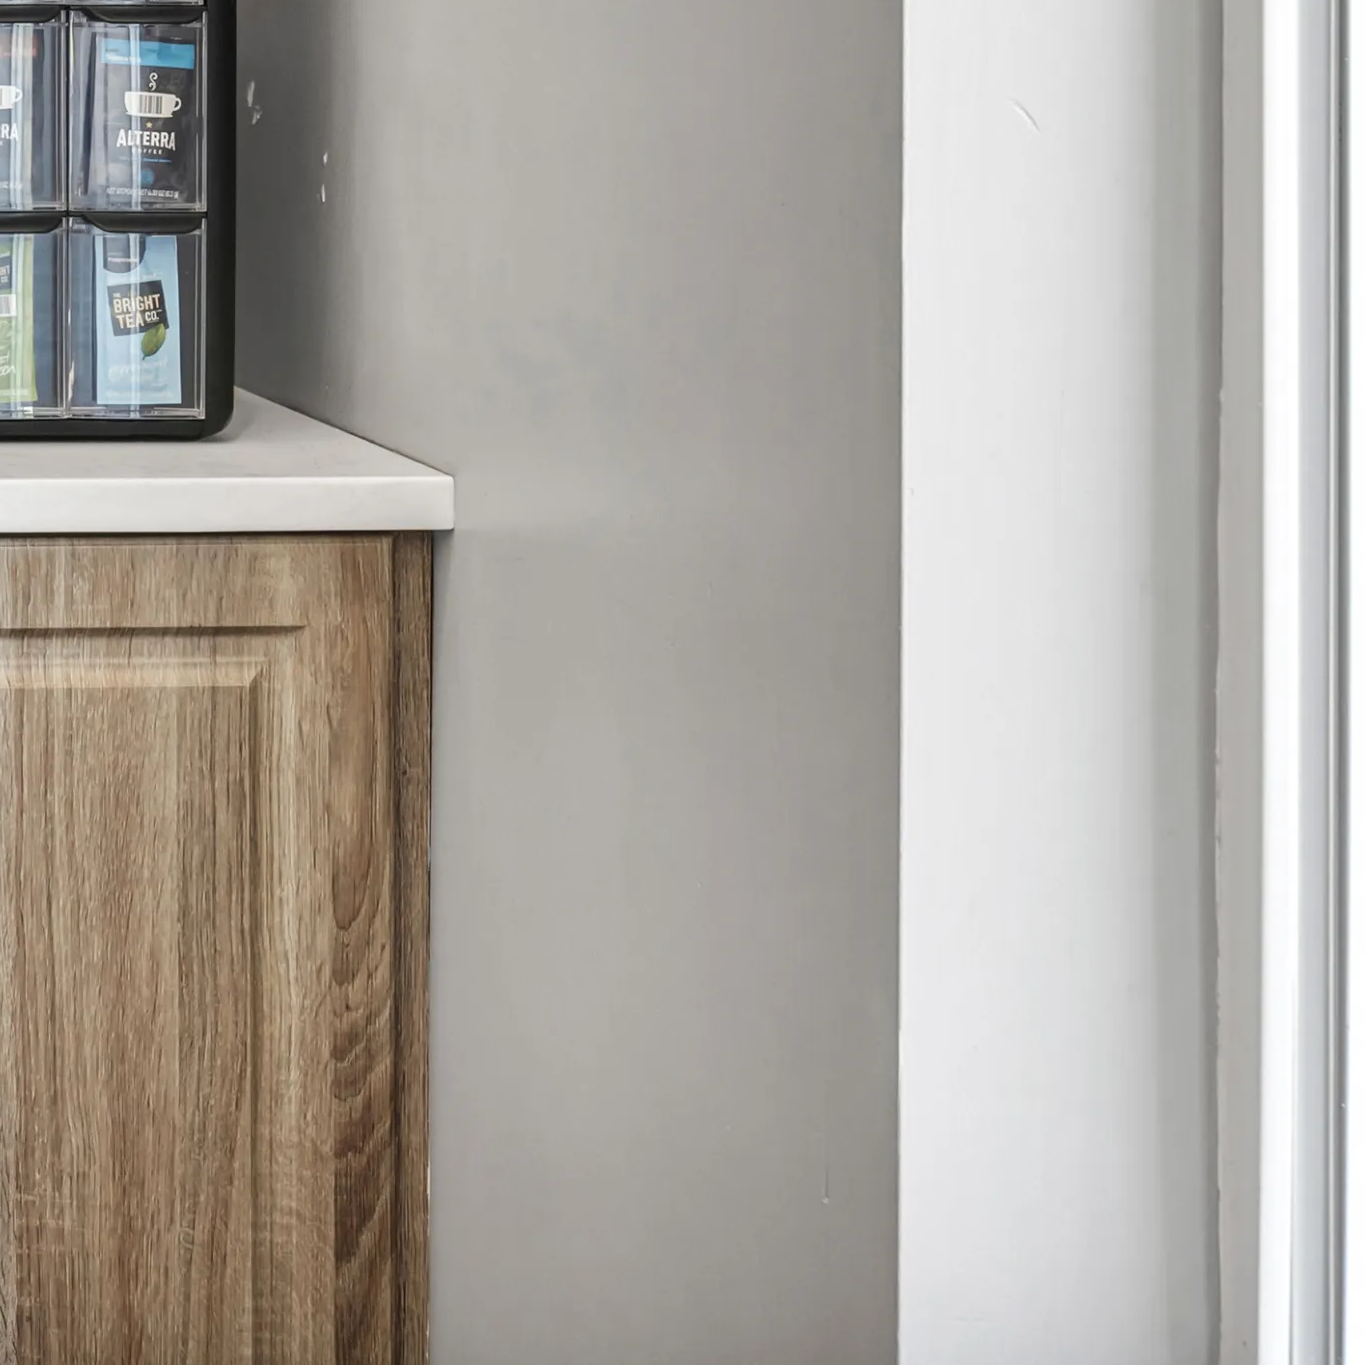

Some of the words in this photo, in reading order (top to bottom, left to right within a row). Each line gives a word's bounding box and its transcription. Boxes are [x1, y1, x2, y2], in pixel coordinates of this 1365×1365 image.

[117, 129, 176, 151] ALTERRA
[113, 294, 160, 313] BRIGHT
[116, 312, 144, 329] TEA
